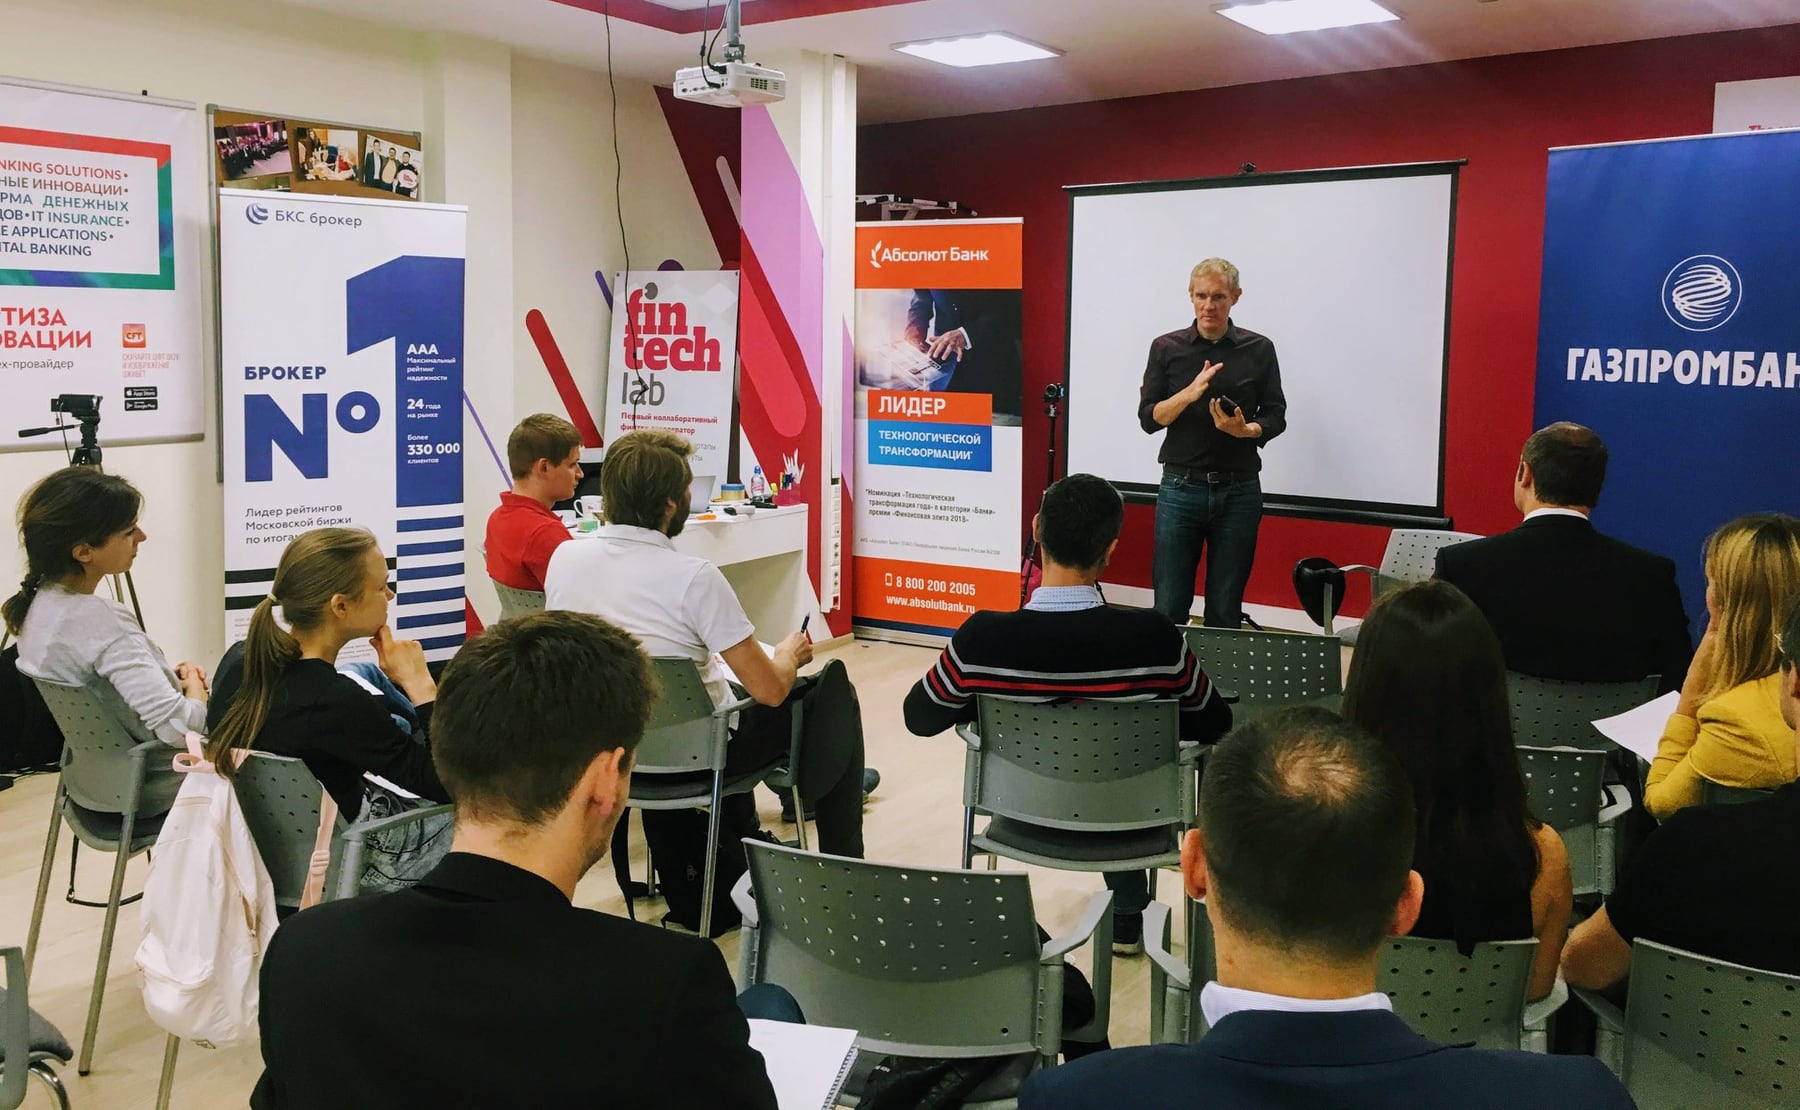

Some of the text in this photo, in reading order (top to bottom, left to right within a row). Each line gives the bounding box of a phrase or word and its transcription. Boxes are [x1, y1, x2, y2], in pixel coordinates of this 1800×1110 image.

[46, 163, 121, 180] SOLUTIONS
[33, 178, 122, 196] ИННОВАЦИИ
[43, 196, 129, 212] ДЕНЕЖНЫХ
[48, 212, 124, 227] INSURANCE
[275, 210, 362, 229] БКС брокер
[11, 226, 107, 241] APPLICATIONS
[30, 244, 92, 256] BANKING
[881, 246, 989, 262] Абсолют Банк
[624, 281, 689, 335] fin
[0, 330, 92, 351] ВАЦИИ
[624, 326, 721, 371] tech
[244, 365, 327, 380] БРОКЕР
[407, 366, 435, 374] рейтинг
[621, 372, 665, 406] lab
[407, 398, 441, 411] 24 года
[878, 396, 947, 418] ЛИДЕР
[621, 411, 718, 425] Первый коллаборативный
[878, 429, 981, 445] ТЕХНОЛОГИЧЕСКОЙ
[407, 442, 461, 456] 330 000
[407, 457, 440, 465] клиентов
[245, 504, 343, 518] Лидер рейтингов
[245, 517, 352, 531] Московской биржи
[245, 536, 260, 545] по
[896, 576, 976, 597] 8 800 200 2005
[886, 595, 976, 614] www.absolutbank.ru
